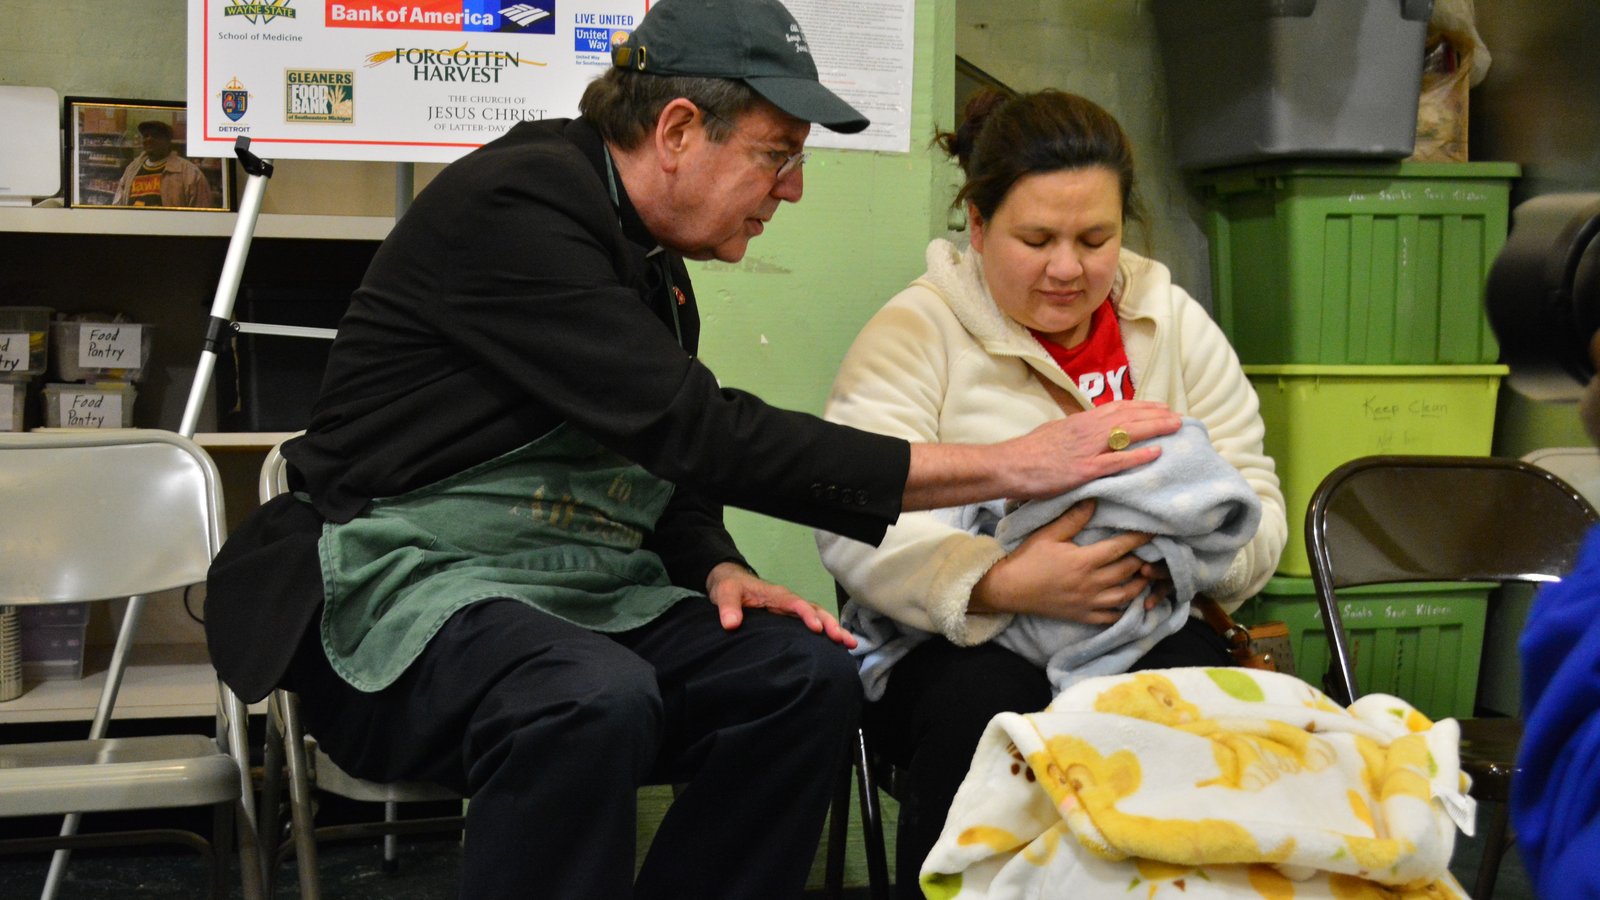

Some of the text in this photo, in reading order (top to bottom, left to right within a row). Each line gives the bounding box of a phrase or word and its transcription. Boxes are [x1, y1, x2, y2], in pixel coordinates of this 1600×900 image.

[227, 5, 293, 17] WAYNE STATE
[331, 4, 494, 26] Bank of America
[575, 13, 634, 26] LIVE UNITED
[218, 32, 248, 40] School
[262, 34, 303, 42] Medicine
[576, 29, 608, 40] United
[588, 40, 608, 51] Way
[395, 47, 520, 68] FORGOTTEN
[288, 72, 352, 84] GLEANERS
[413, 66, 503, 84] HARVEST
[292, 84, 328, 99] FOOD
[292, 98, 329, 114] BANK
[448, 95, 468, 103] THE
[470, 95, 511, 104] CHURCH
[427, 106, 548, 121] JESUS CHRIST
[433, 123, 446, 131] OF
[449, 123, 507, 132] LATTER-DAY
[89, 327, 120, 342] Food
[88, 342, 125, 361] Pantry
[72, 395, 104, 408] Food
[1362, 395, 1448, 417] Keep Clean
[67, 409, 105, 427] Pantry
